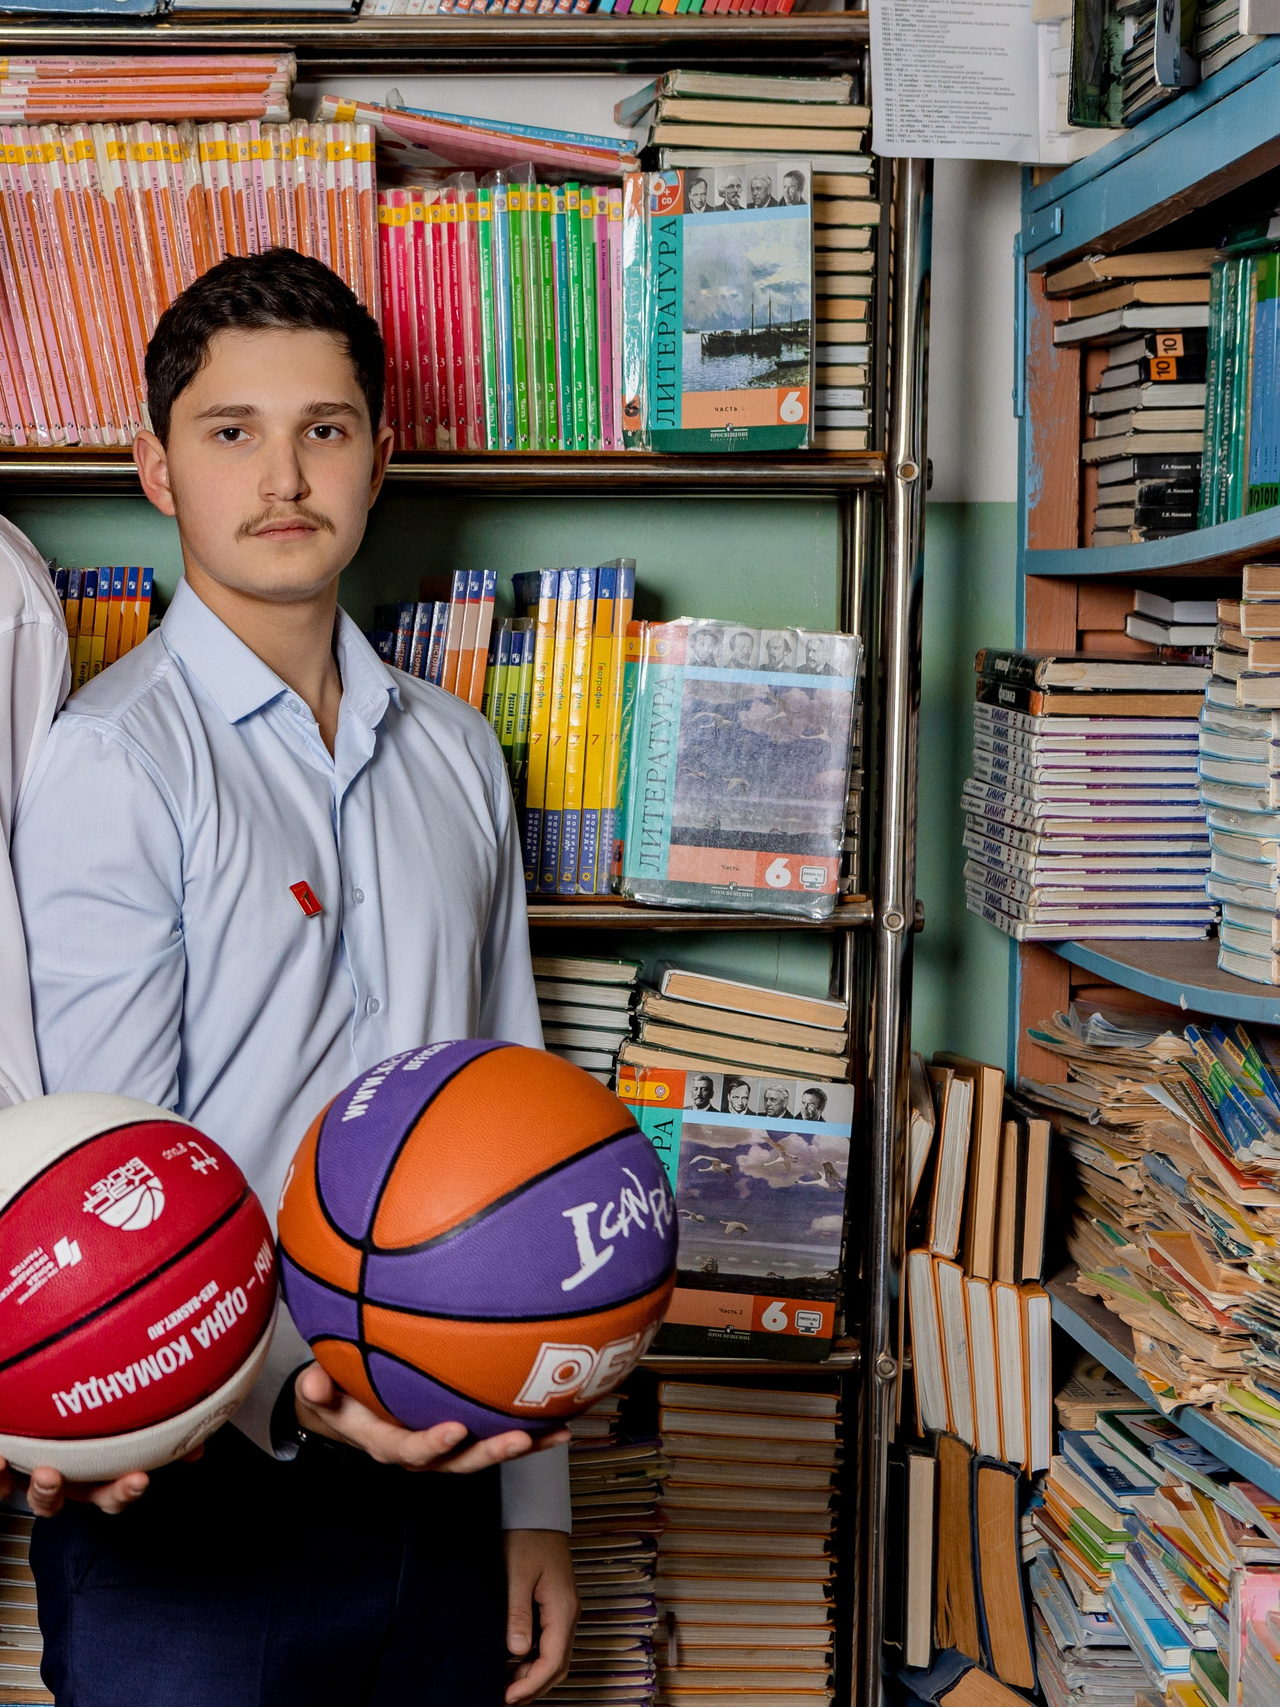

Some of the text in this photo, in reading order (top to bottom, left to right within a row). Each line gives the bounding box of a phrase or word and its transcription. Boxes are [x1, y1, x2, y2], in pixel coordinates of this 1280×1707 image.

[656, 218, 677, 426] ЛИТЕРАТУРА
[1163, 338, 1177, 353] 10
[1156, 361, 1170, 377] 10
[548, 383, 553, 392] 3
[779, 391, 804, 423] 6
[507, 693, 517, 718] Русский
[534, 661, 547, 745] География 7
[591, 662, 606, 746] География 7
[639, 675, 675, 872] ЛИТЕРАТУРА
[984, 803, 1006, 820] ХИМИЯ
[530, 813, 539, 863] ПОЛЯРНАЯ
[583, 814, 591, 852] ЗВЕЗДА
[588, 814, 596, 864] ПОЛЯРНАЯ
[982, 840, 1001, 857] ХИМИЯ
[765, 858, 791, 887] 6
[985, 869, 1008, 891] ХИМИЯ
[710, 890, 754, 898] ПРОСВЕЩЕНИЕ
[10, 1246, 44, 1278] ГРАНТОВ
[26, 1262, 55, 1286] ФОНДА
[147, 1280, 220, 1340] KES-BASKET.RU
[191, 1286, 248, 1349] ОДНА
[719, 1307, 737, 1315] Часть
[762, 1302, 788, 1331] 6
[708, 1332, 751, 1340] ПРОСВЕЩЕНИЕ
[52, 1335, 194, 1417] КОМАНДА!
